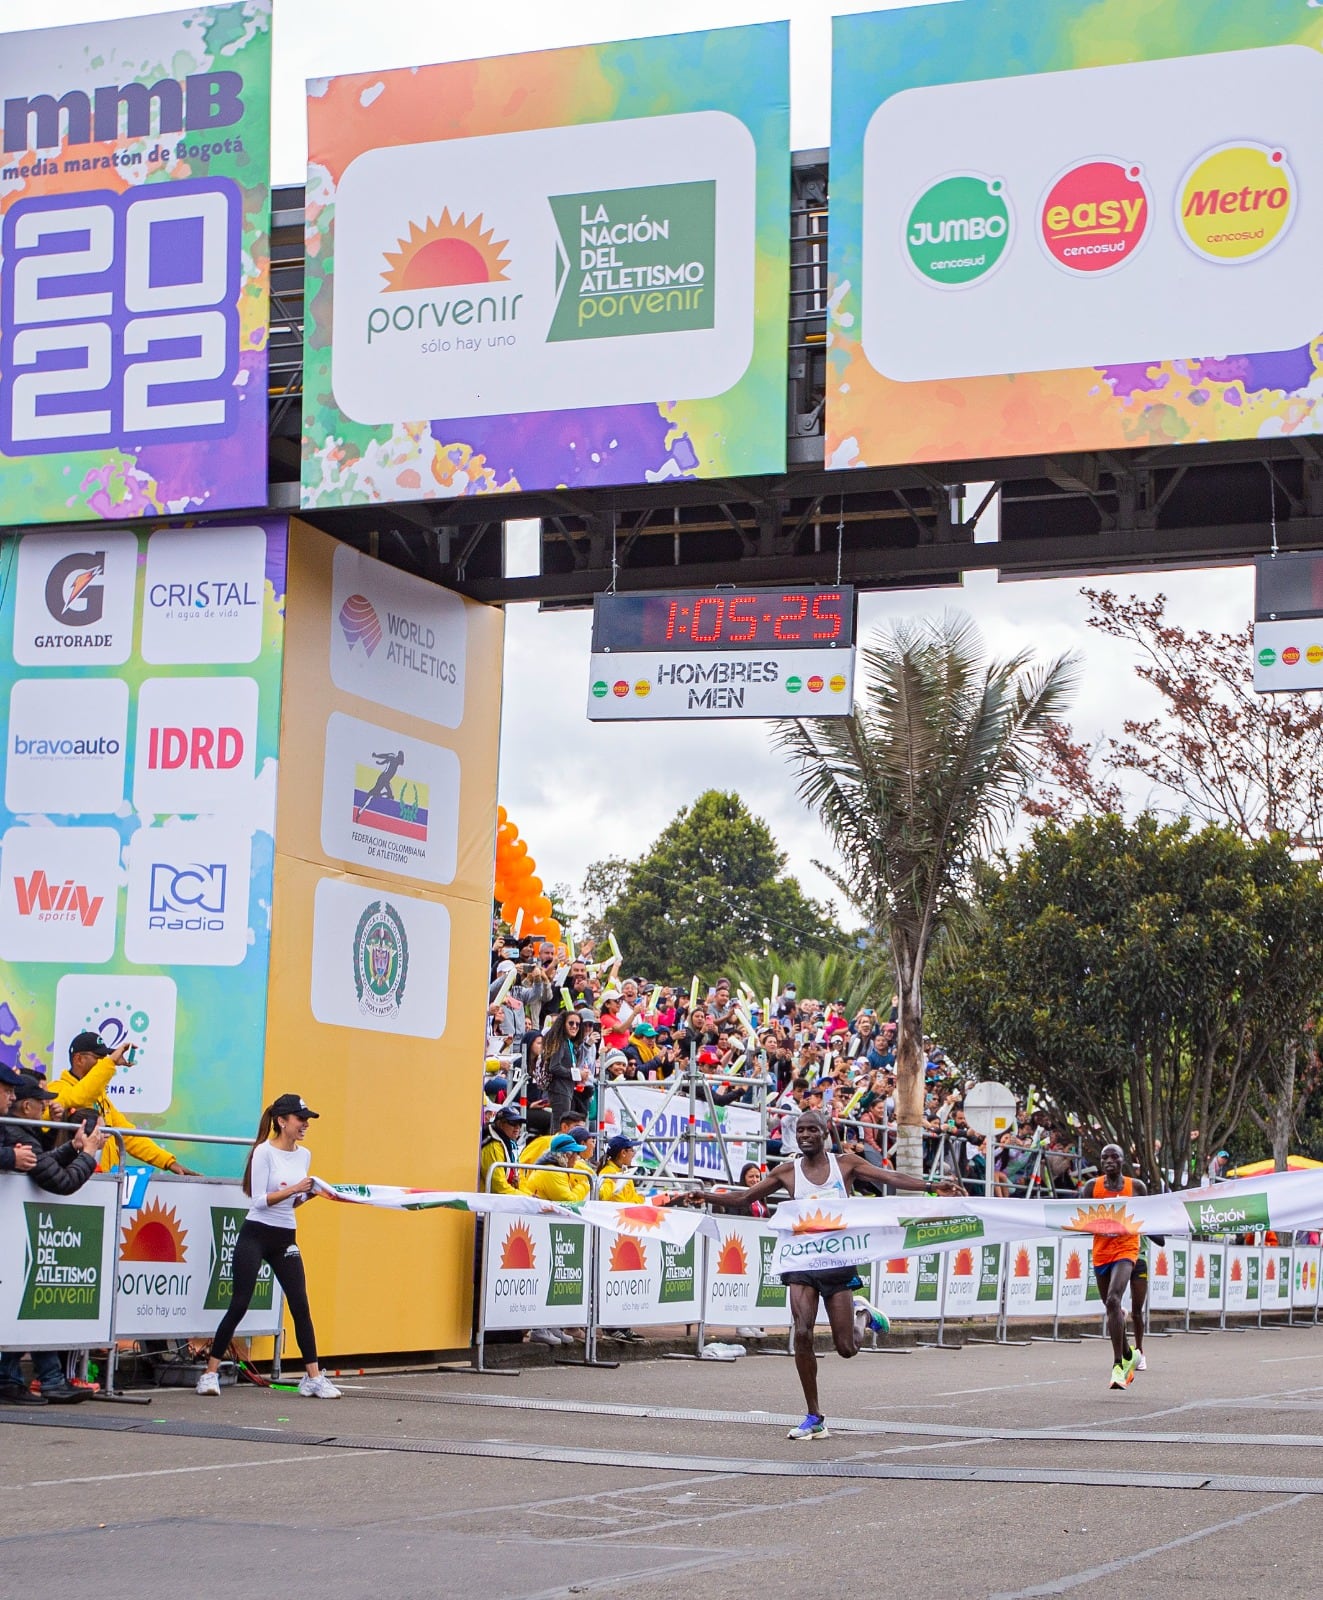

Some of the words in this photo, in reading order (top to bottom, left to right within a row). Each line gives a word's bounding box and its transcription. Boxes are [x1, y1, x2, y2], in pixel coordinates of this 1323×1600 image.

[4, 71, 244, 153] mmB
[3, 158, 58, 180] media
[64, 150, 142, 173] maratón
[147, 145, 171, 162] de
[175, 136, 244, 162] Bogotá
[1183, 186, 1288, 218] Metro
[580, 203, 609, 226] LA
[1046, 198, 1144, 232] easy
[580, 215, 669, 247] NACIÓN
[909, 215, 1006, 246] JUMBO
[1206, 228, 1264, 244] cencosud
[14, 191, 228, 325] 20
[580, 247, 623, 270] DEL
[1063, 240, 1125, 257] cencosud
[930, 254, 985, 270] cencosud
[579, 261, 704, 293] ATLETISMO
[578, 288, 704, 327] porvenir
[368, 294, 523, 344] porvenir
[421, 338, 450, 353] sólo
[456, 336, 482, 352] hay
[487, 334, 516, 348] uno
[11, 310, 227, 442] 22
[150, 581, 257, 608] CRISTAL
[166, 610, 174, 618] el
[178, 611, 200, 621] agua
[204, 609, 215, 617] de
[219, 609, 239, 617] vida
[387, 612, 435, 650] WORLD
[34, 635, 113, 648] GATORADE
[386, 641, 457, 684] ATHLETICS
[657, 662, 778, 685] HOMBRES
[688, 687, 744, 709] MEN
[15, 735, 120, 755] bravoauto
[148, 728, 244, 769] IDRD
[352, 832, 388, 849] FEDERACION
[388, 841, 426, 858] COLOMBIANA
[368, 847, 375, 856] DE
[376, 850, 408, 864] ATLETISMO
[38, 911, 77, 922] sports
[149, 916, 224, 931] Radio
[1200, 1204, 1215, 1214] LA
[1201, 1208, 1246, 1224] NACIÓN
[39, 1212, 53, 1229] LA
[223, 1216, 236, 1231] LA
[38, 1227, 82, 1248] NACIÓN
[555, 1230, 563, 1243] LA
[917, 1222, 978, 1242] porvenir
[37, 1248, 58, 1265] DEL
[221, 1247, 235, 1262] DE
[555, 1239, 575, 1254] NACIÓN
[764, 1242, 771, 1253] LA
[780, 1233, 871, 1264] porvenir
[555, 1255, 566, 1267] DEL
[666, 1256, 676, 1267] DEL
[830, 1258, 848, 1268] hay
[35, 1266, 97, 1284] ATLETISMO
[554, 1267, 582, 1280] ATLETISMO
[665, 1267, 693, 1279] ATLETISMO
[33, 1287, 96, 1310] porvenir
[494, 1278, 539, 1304] porvenir
[553, 1282, 582, 1299] porvenir
[606, 1278, 651, 1304] porvenir
[665, 1280, 692, 1297] porvenir
[712, 1282, 750, 1303] porvenir
[136, 1304, 153, 1316] sólo
[155, 1304, 170, 1318] hay
[172, 1306, 187, 1316] uno
